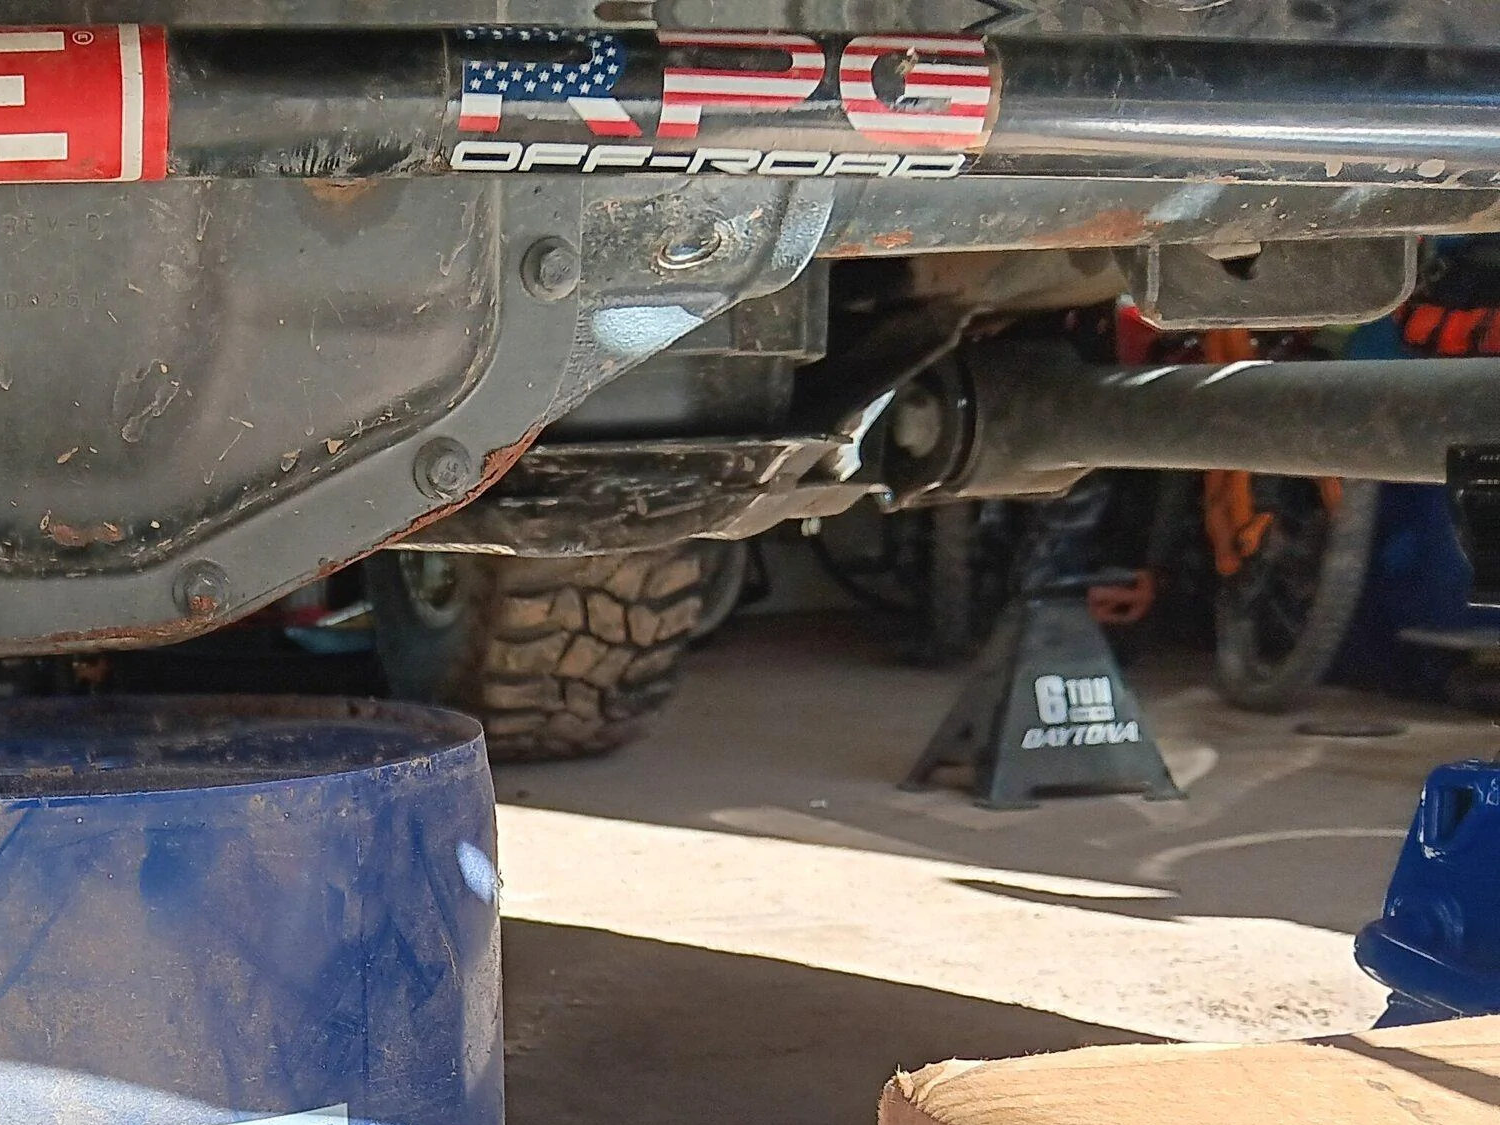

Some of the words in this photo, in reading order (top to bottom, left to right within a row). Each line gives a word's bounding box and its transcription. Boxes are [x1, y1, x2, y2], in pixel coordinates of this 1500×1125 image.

[457, 28, 992, 147] RPG
[449, 141, 967, 178] OFF-ROAD
[1035, 675, 1068, 725] 6
[1021, 721, 1141, 749] DAYTONA
